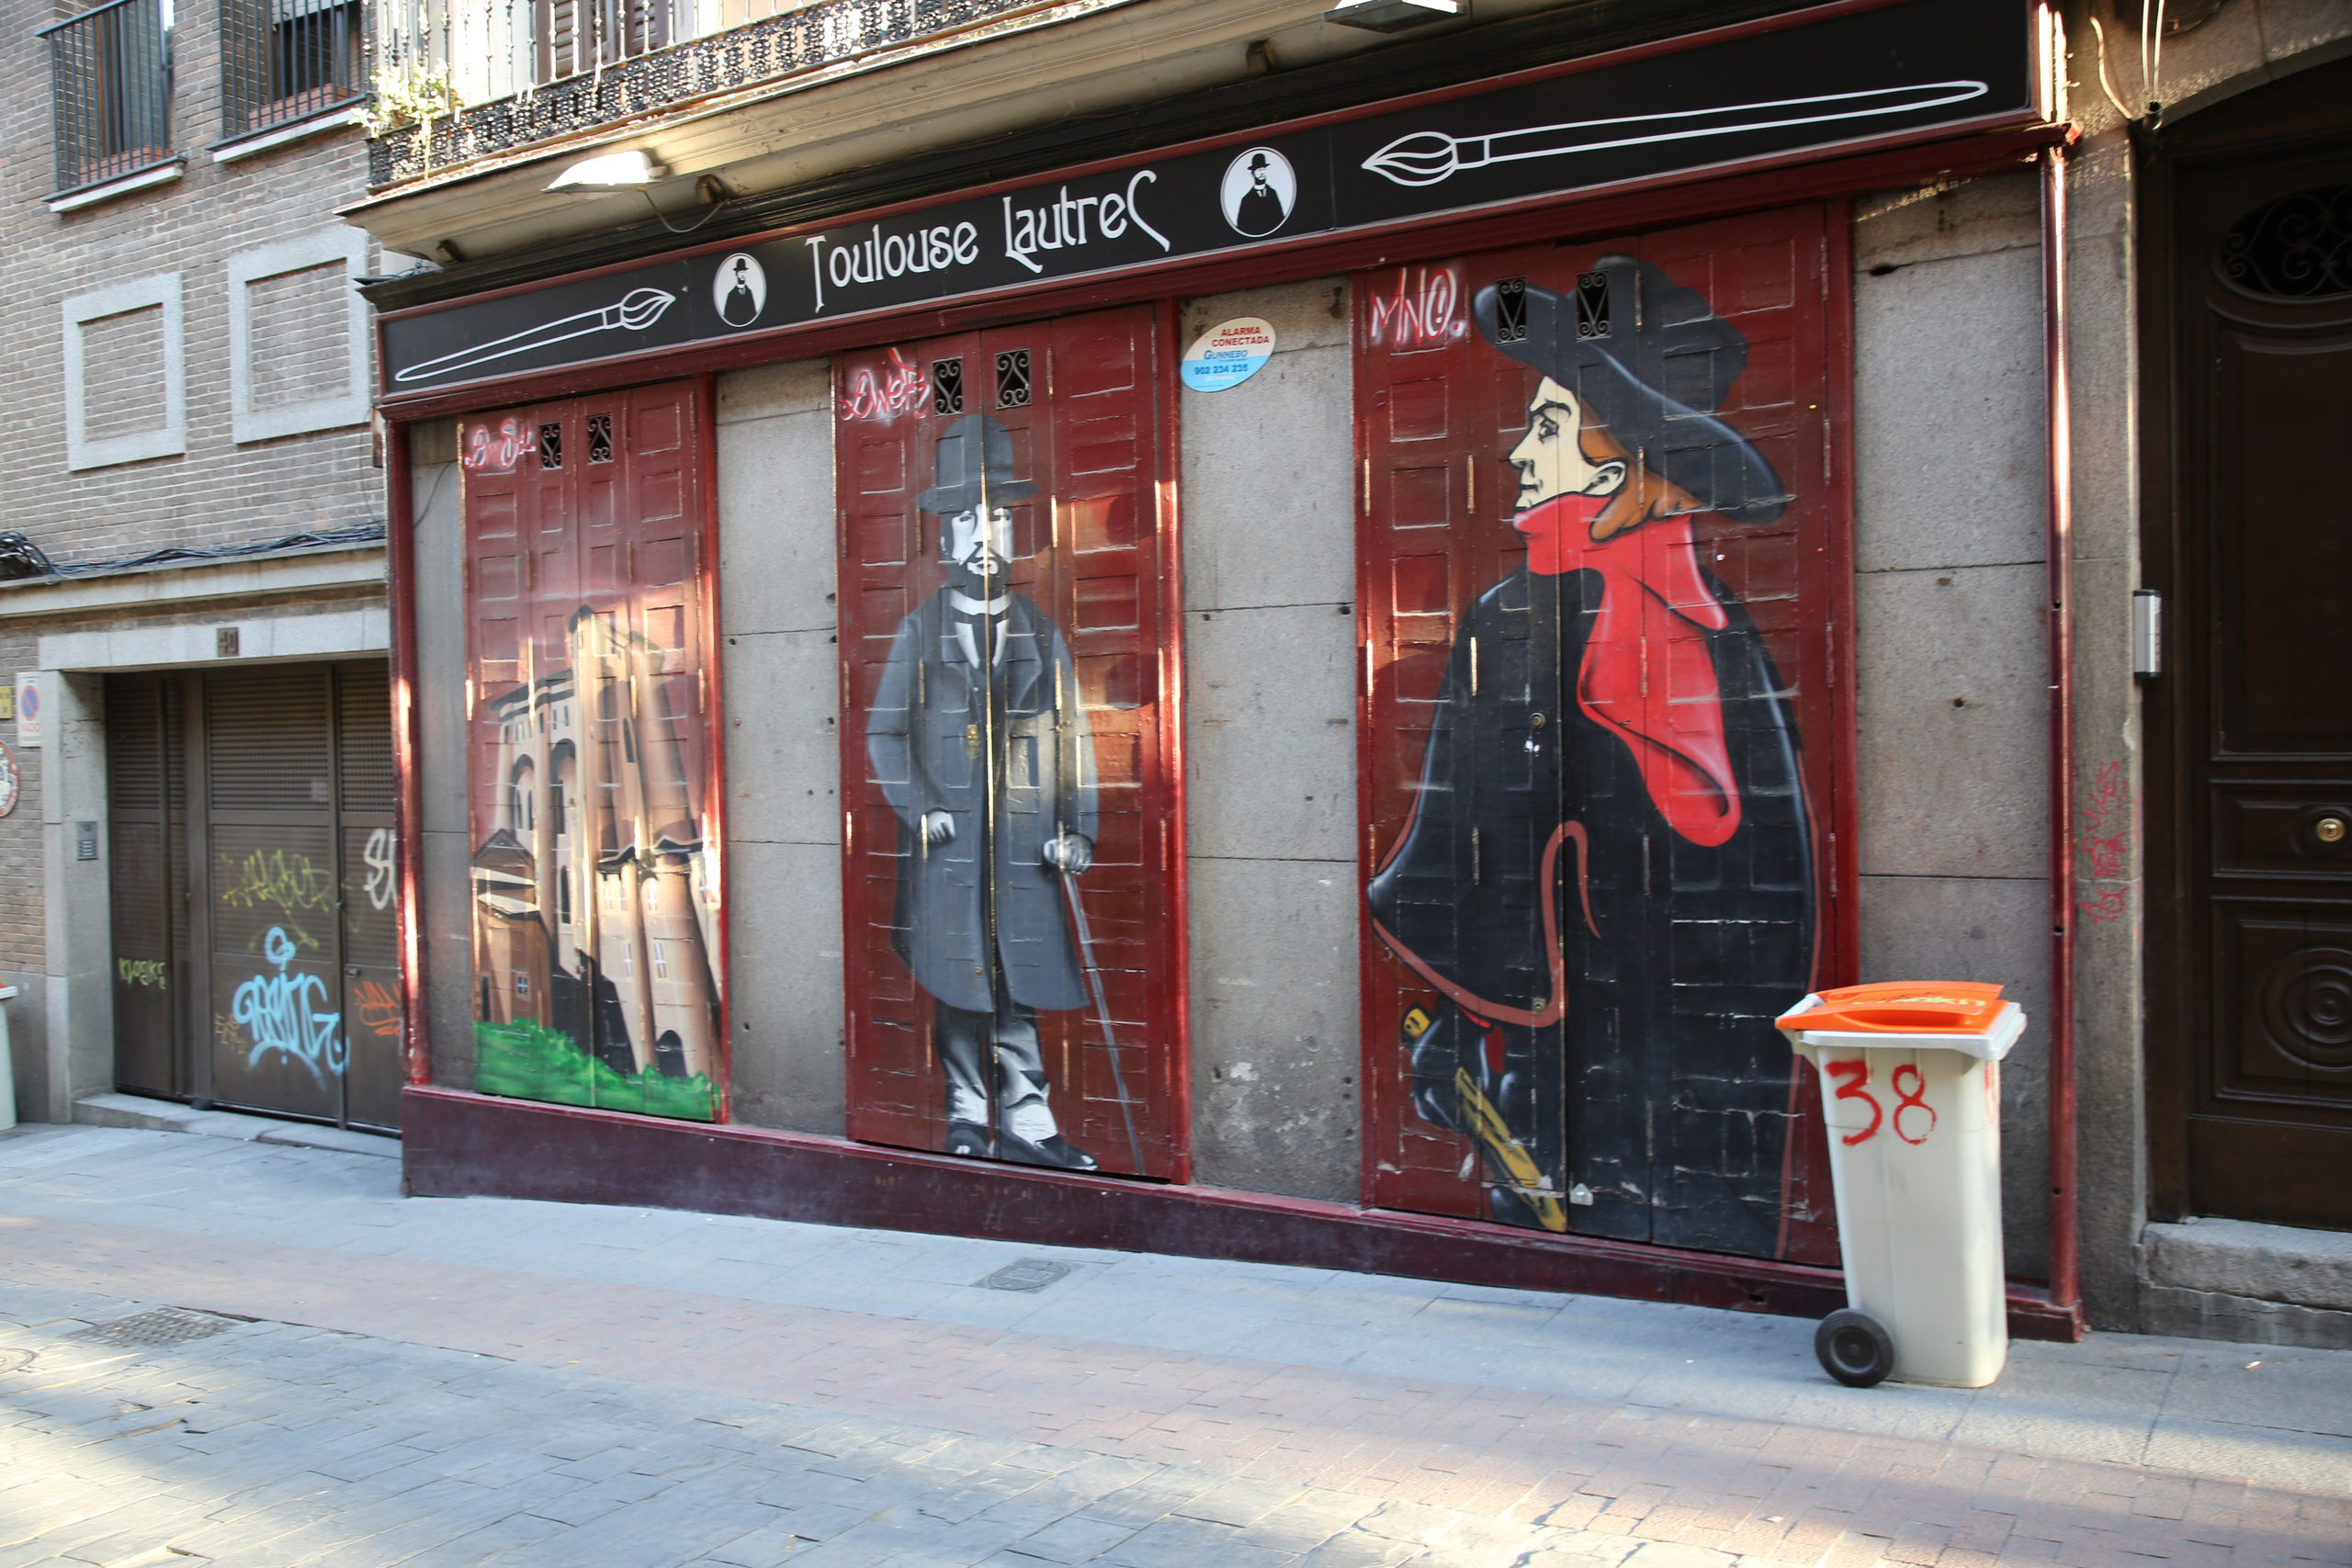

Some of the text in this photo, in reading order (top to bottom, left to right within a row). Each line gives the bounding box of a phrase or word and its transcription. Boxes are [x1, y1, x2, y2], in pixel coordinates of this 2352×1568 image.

[805, 221, 979, 313] Toulouse
[1221, 326, 1261, 336] ALARMA
[1212, 336, 1270, 347] CONECTADA
[1194, 364, 1248, 375] 902 234 235
[1824, 1058, 1938, 1147] 38
